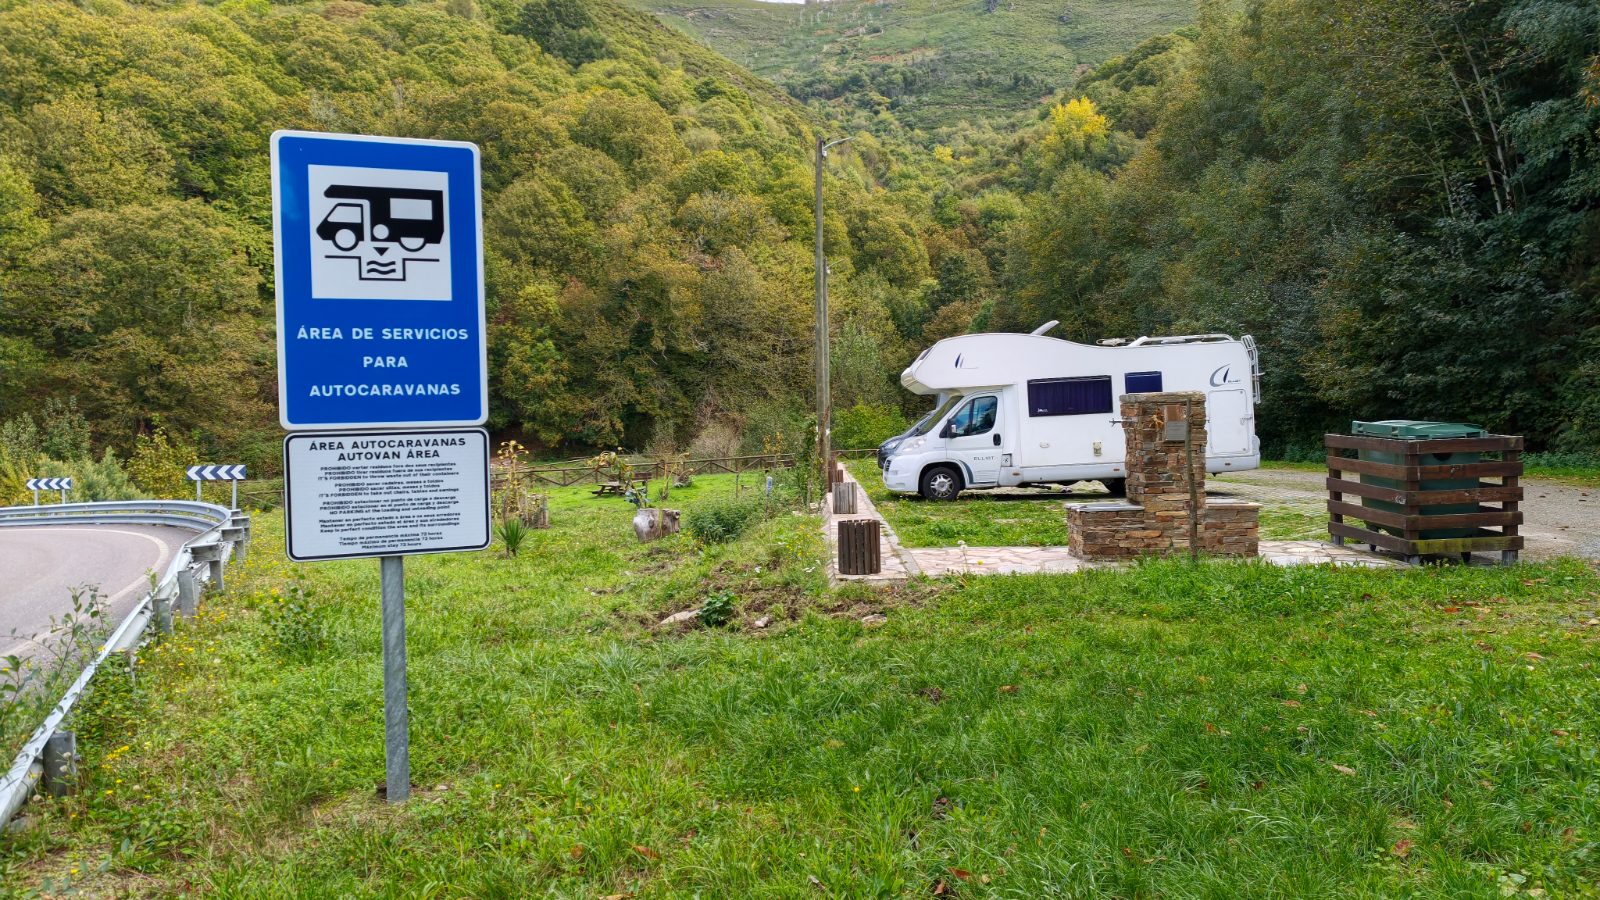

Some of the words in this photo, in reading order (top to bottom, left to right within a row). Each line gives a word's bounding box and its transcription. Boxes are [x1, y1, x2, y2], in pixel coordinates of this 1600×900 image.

[297, 325, 343, 340] ÁREA
[352, 328, 373, 340] DE
[382, 328, 469, 340] SERVICIOS
[363, 356, 408, 368] PARA
[309, 384, 461, 397] AUTOCARAVANAS
[309, 441, 344, 450] ÁREA
[352, 438, 466, 448] AUTOCARAVANAS
[338, 452, 400, 460] AUTOVAN
[407, 448, 439, 458] ÁREA
